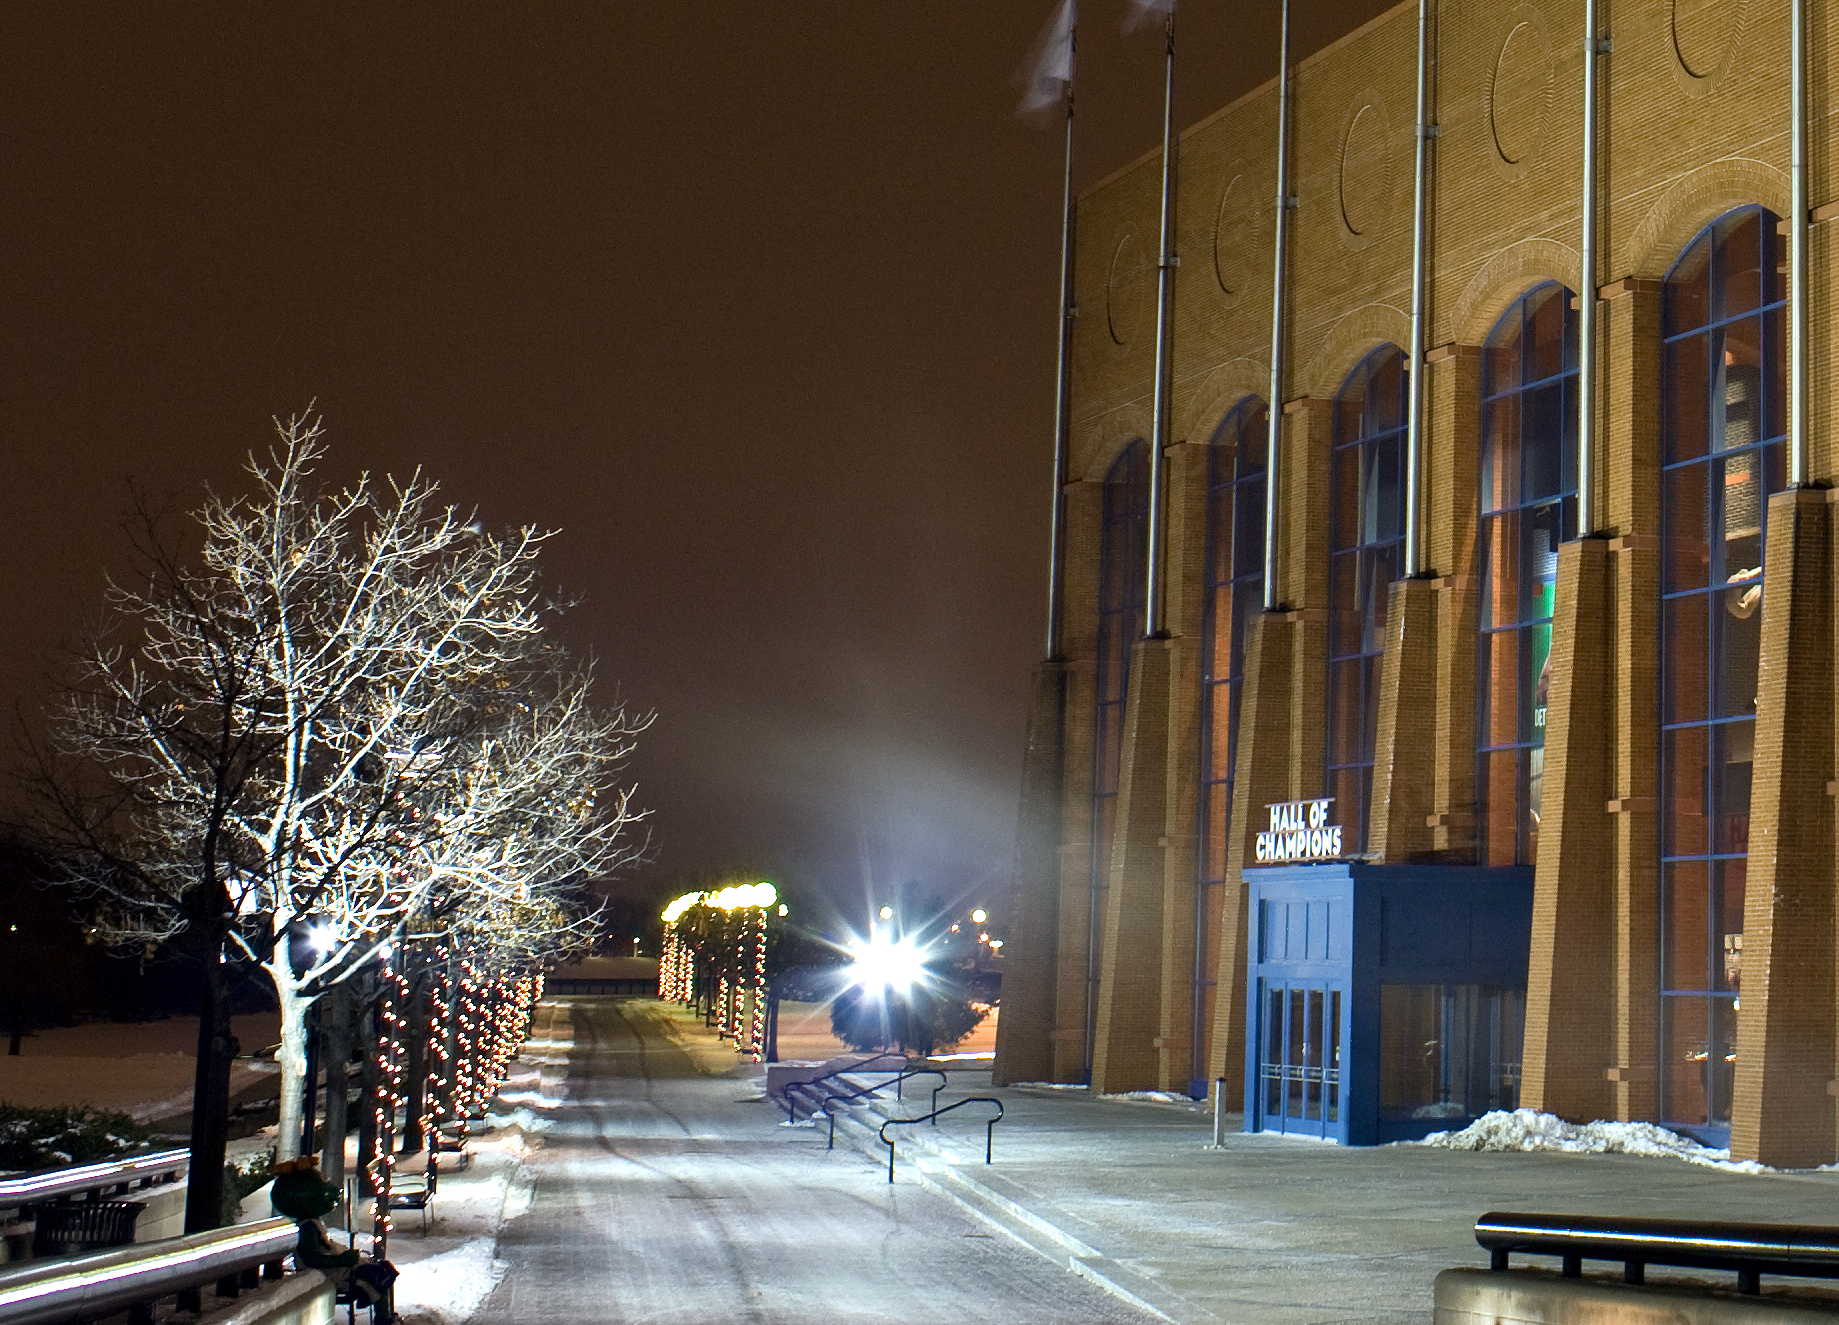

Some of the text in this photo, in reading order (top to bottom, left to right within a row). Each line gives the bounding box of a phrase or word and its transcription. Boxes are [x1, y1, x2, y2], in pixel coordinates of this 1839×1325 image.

[1269, 800, 1329, 833] HALL OF
[1255, 827, 1342, 861] CHAMPIONS
